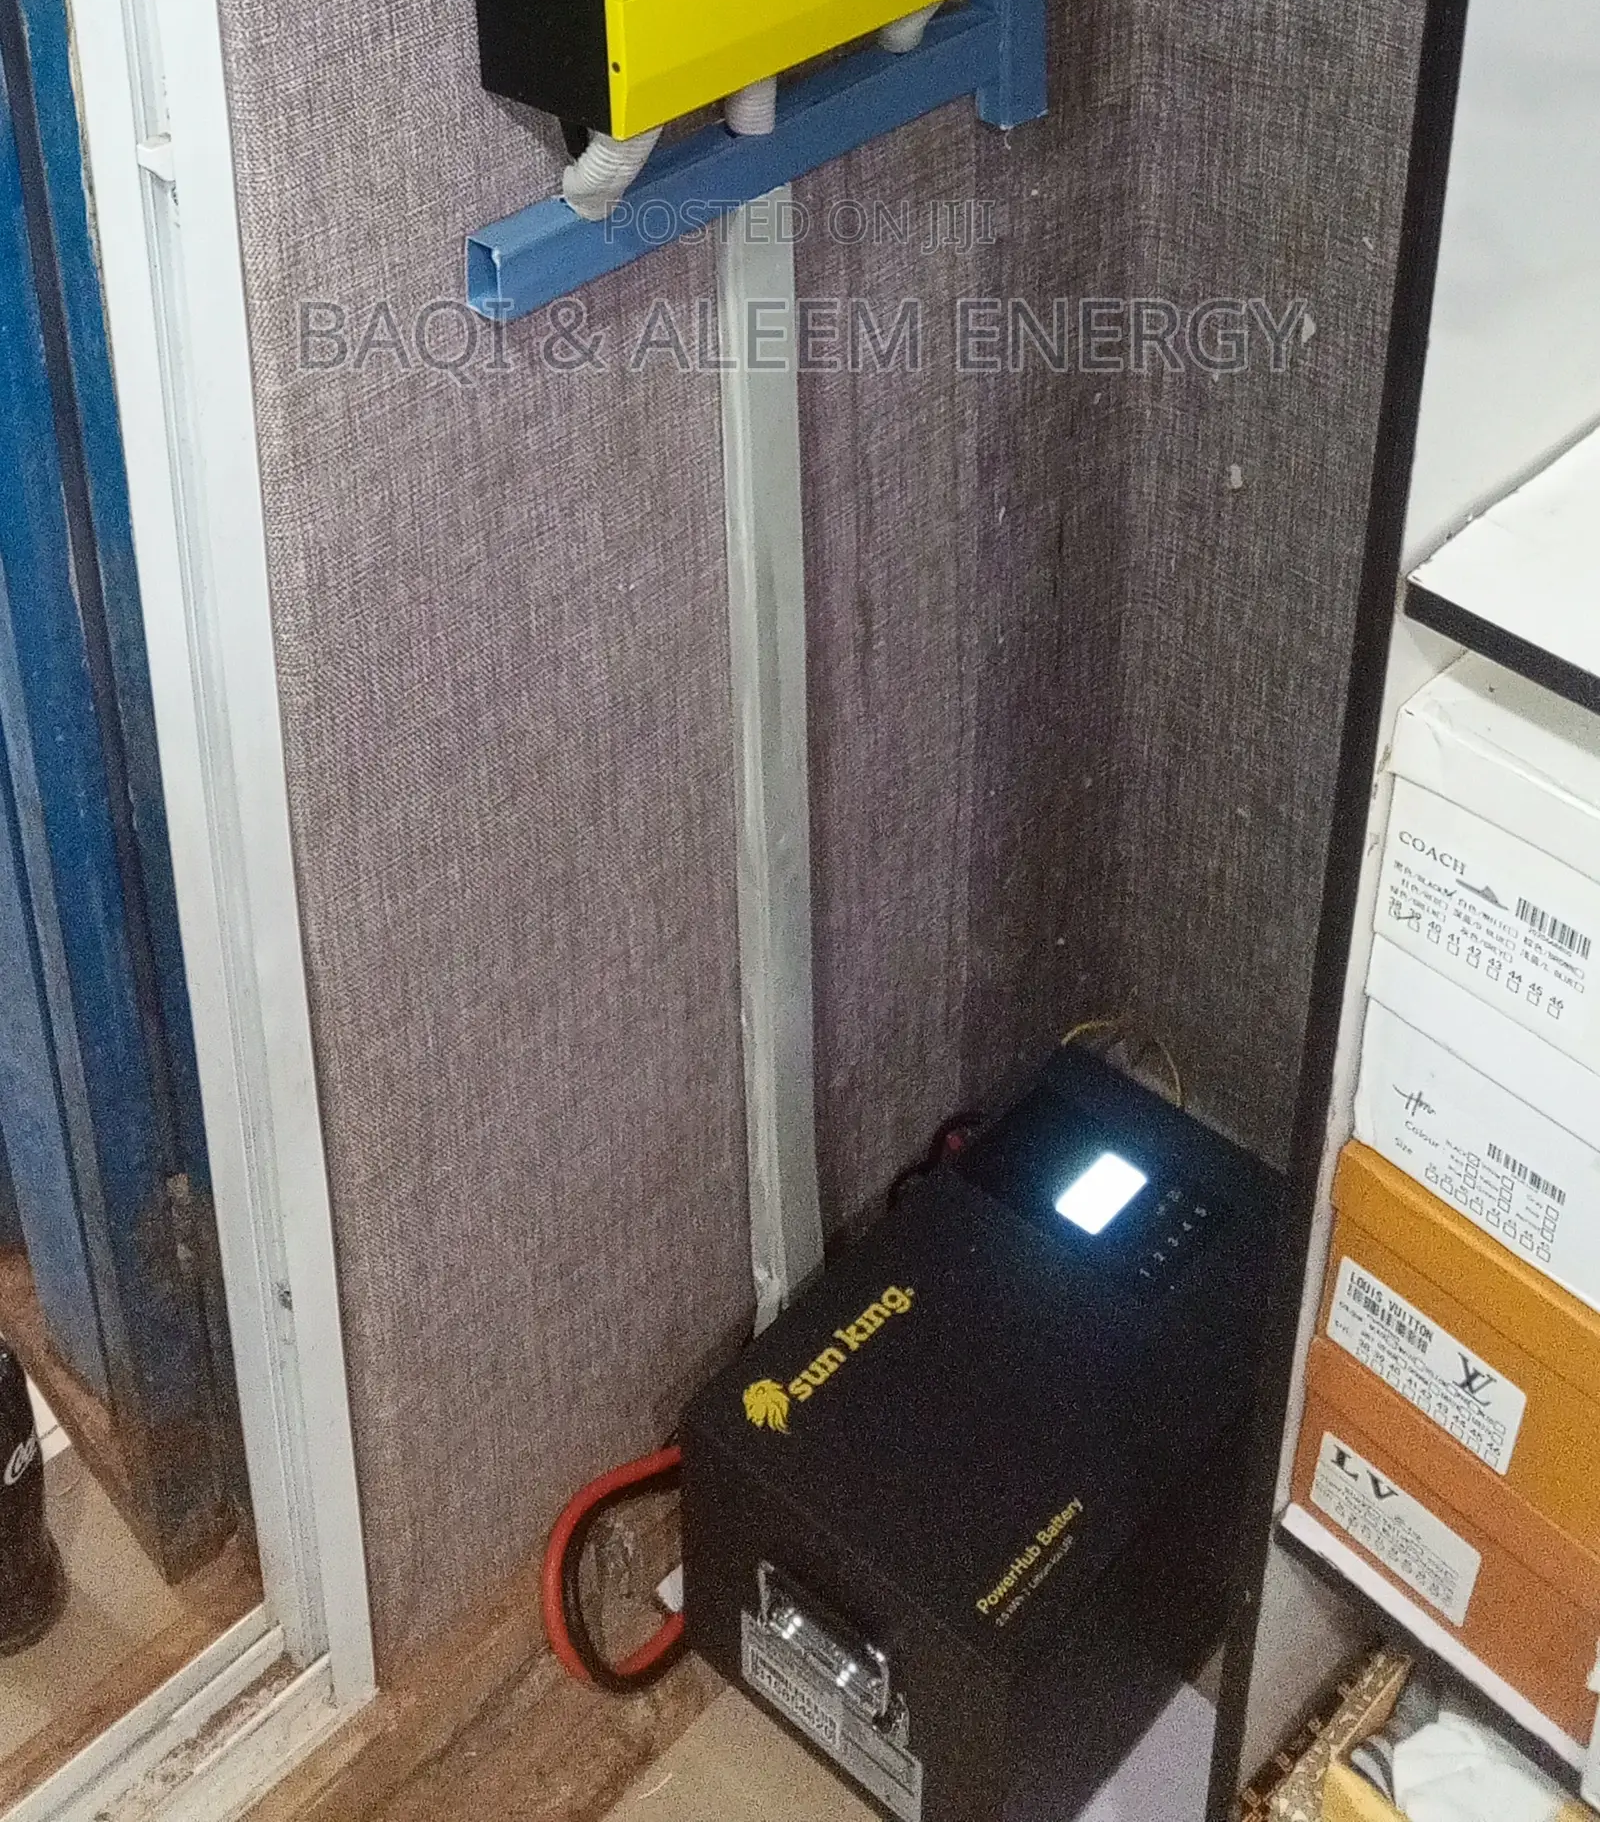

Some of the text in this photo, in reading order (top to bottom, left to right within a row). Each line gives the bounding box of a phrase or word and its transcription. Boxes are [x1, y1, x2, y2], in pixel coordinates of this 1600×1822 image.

[1398, 830, 1466, 876] COACH
[1428, 921, 1442, 935] 40
[1447, 933, 1461, 946] 41
[1467, 945, 1482, 958] 42
[1488, 957, 1502, 971] 43
[1508, 970, 1522, 983] 44
[1528, 982, 1543, 996] 45
[1549, 996, 1564, 1009] 46
[1350, 1271, 1383, 1303] LOUIS
[1388, 1299, 1433, 1343] VUITTON
[788, 1346, 847, 1403] sun
[976, 1495, 1083, 1615] PowerHub Battery
